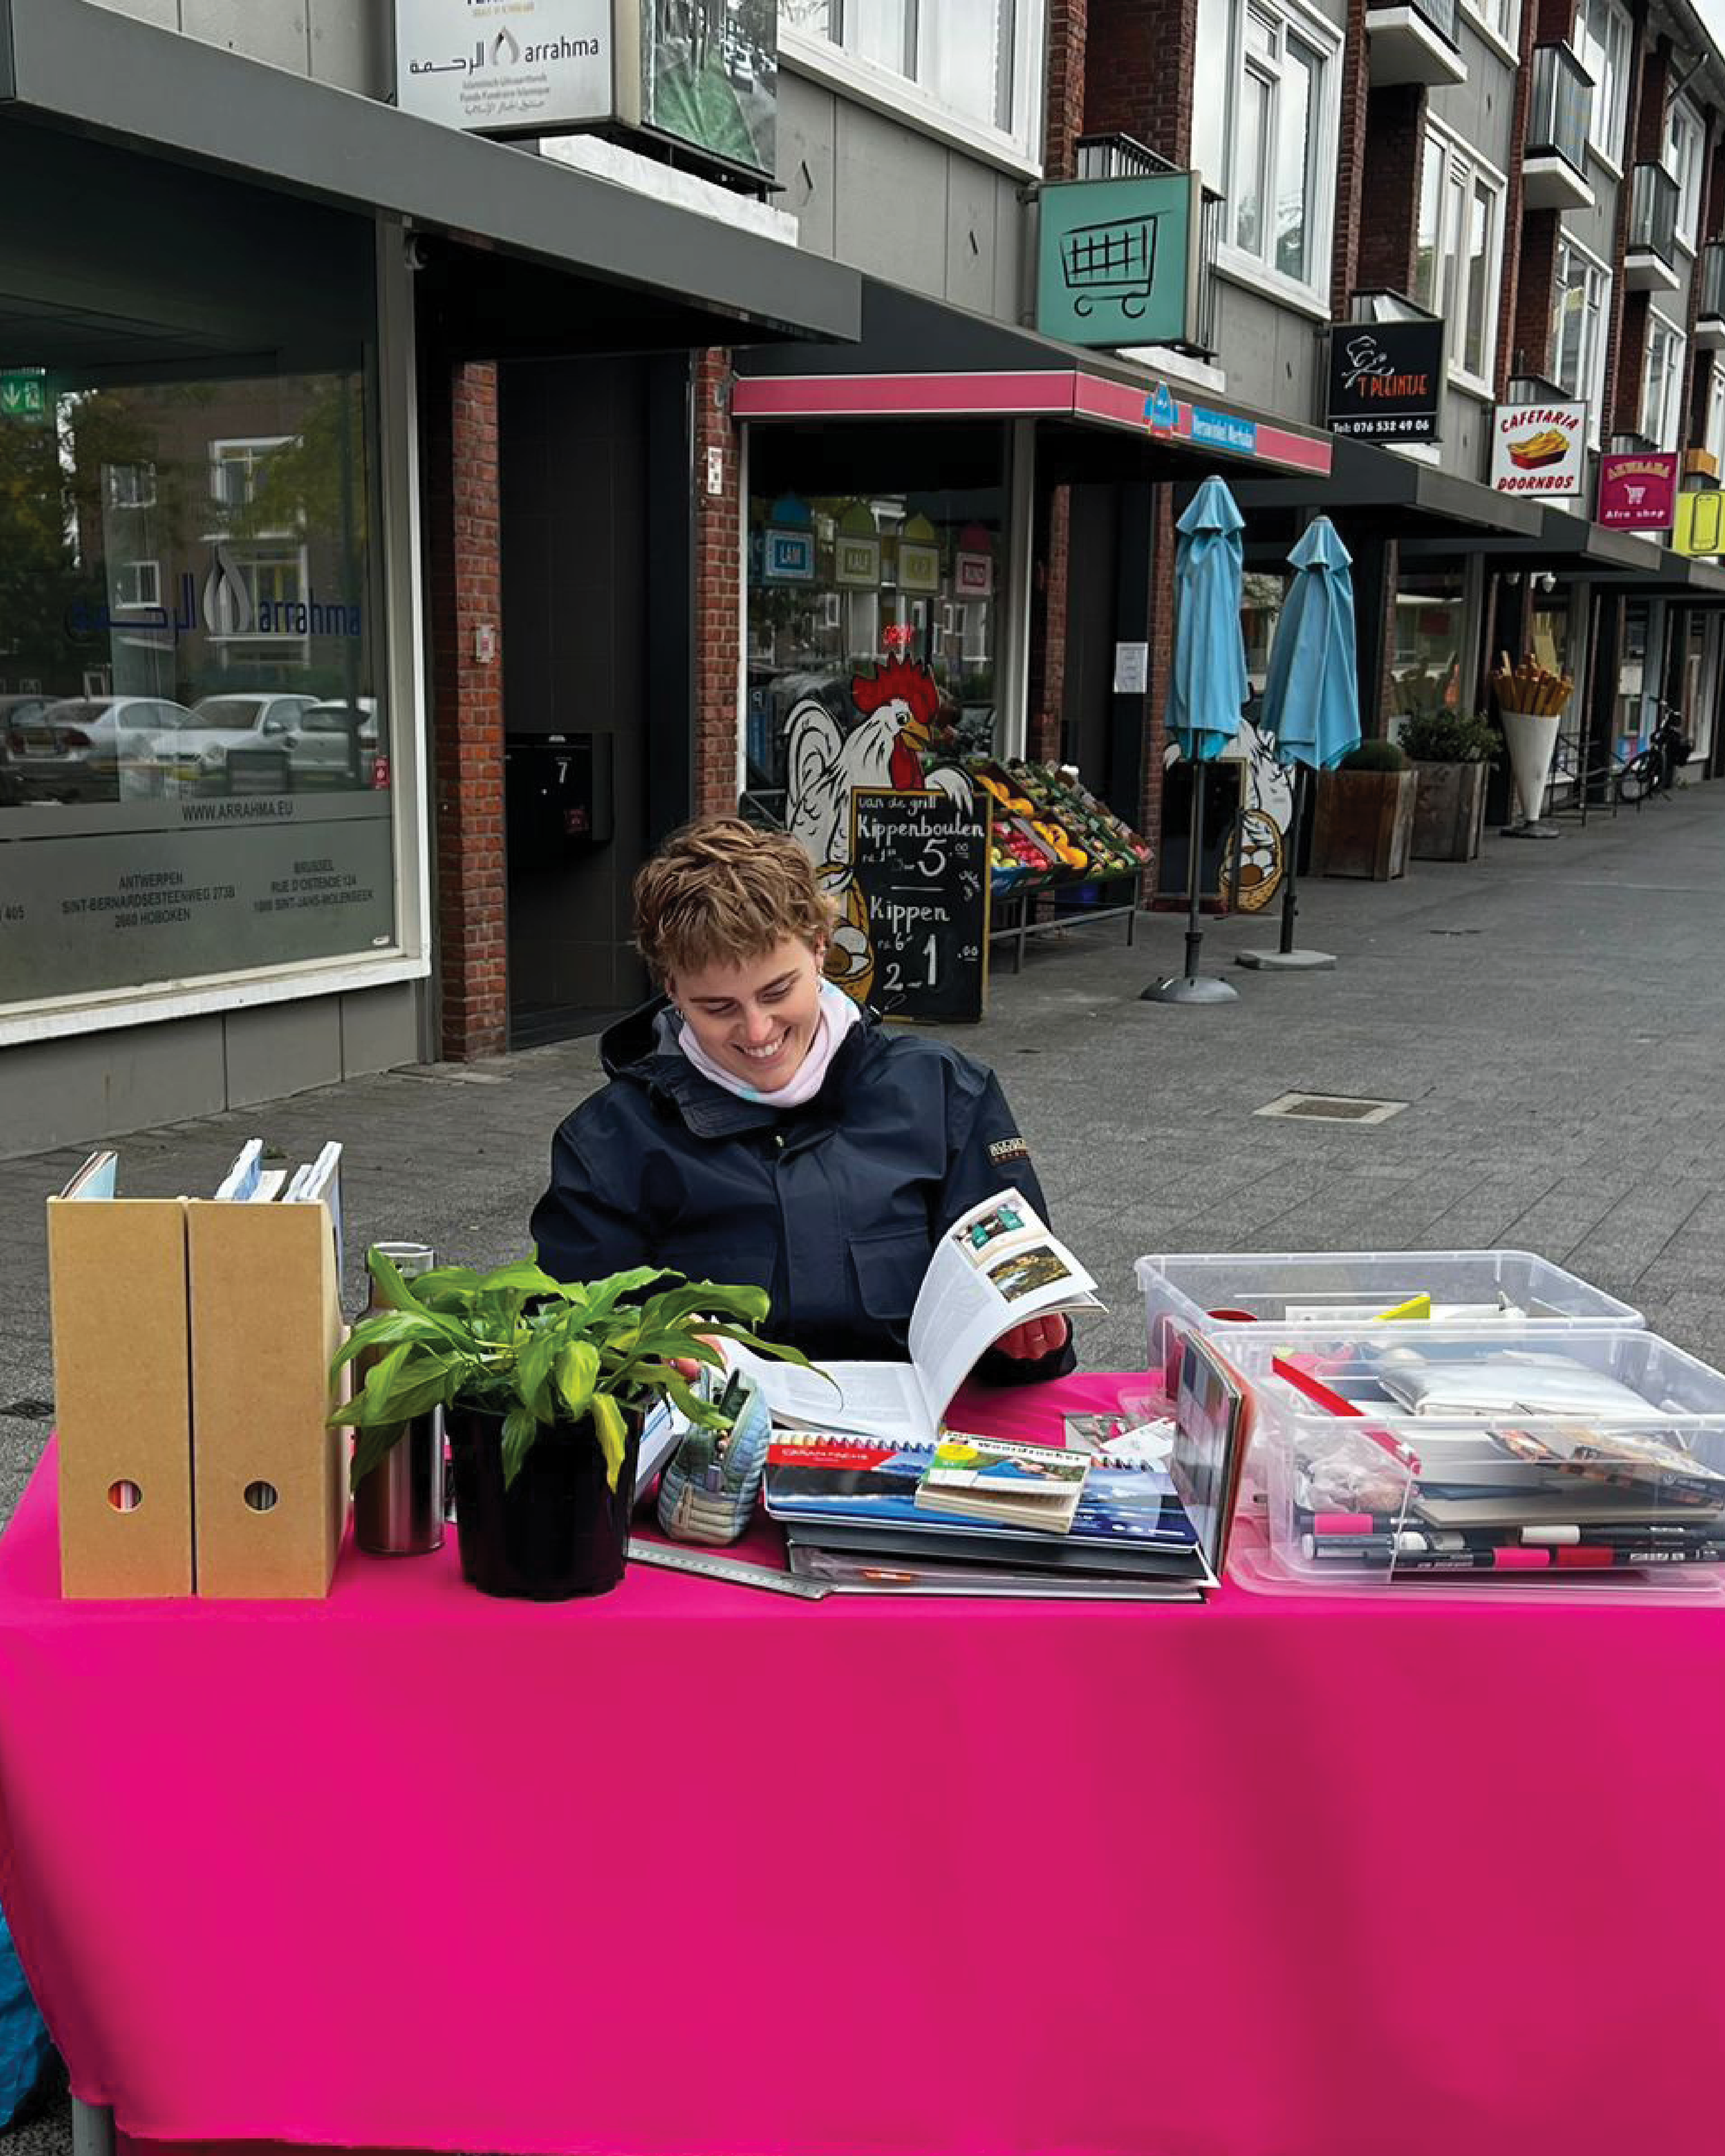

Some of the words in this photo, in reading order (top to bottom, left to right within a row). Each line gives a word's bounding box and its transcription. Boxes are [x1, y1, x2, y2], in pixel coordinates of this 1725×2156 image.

[524, 35, 598, 63] arrahma
[1353, 422, 1374, 433] 076
[1399, 419, 1413, 431] 49
[1500, 409, 1579, 433] CAFETARIA
[1497, 475, 1575, 491] DOORNBOS
[259, 587, 361, 636] arrahma
[558, 761, 569, 784] 7
[181, 799, 293, 822] WWW.ARRAHMA.EU
[119, 871, 184, 891] ANTWERPEN
[140, 908, 190, 926] HOBOKEN
[870, 896, 951, 934] Kippen
